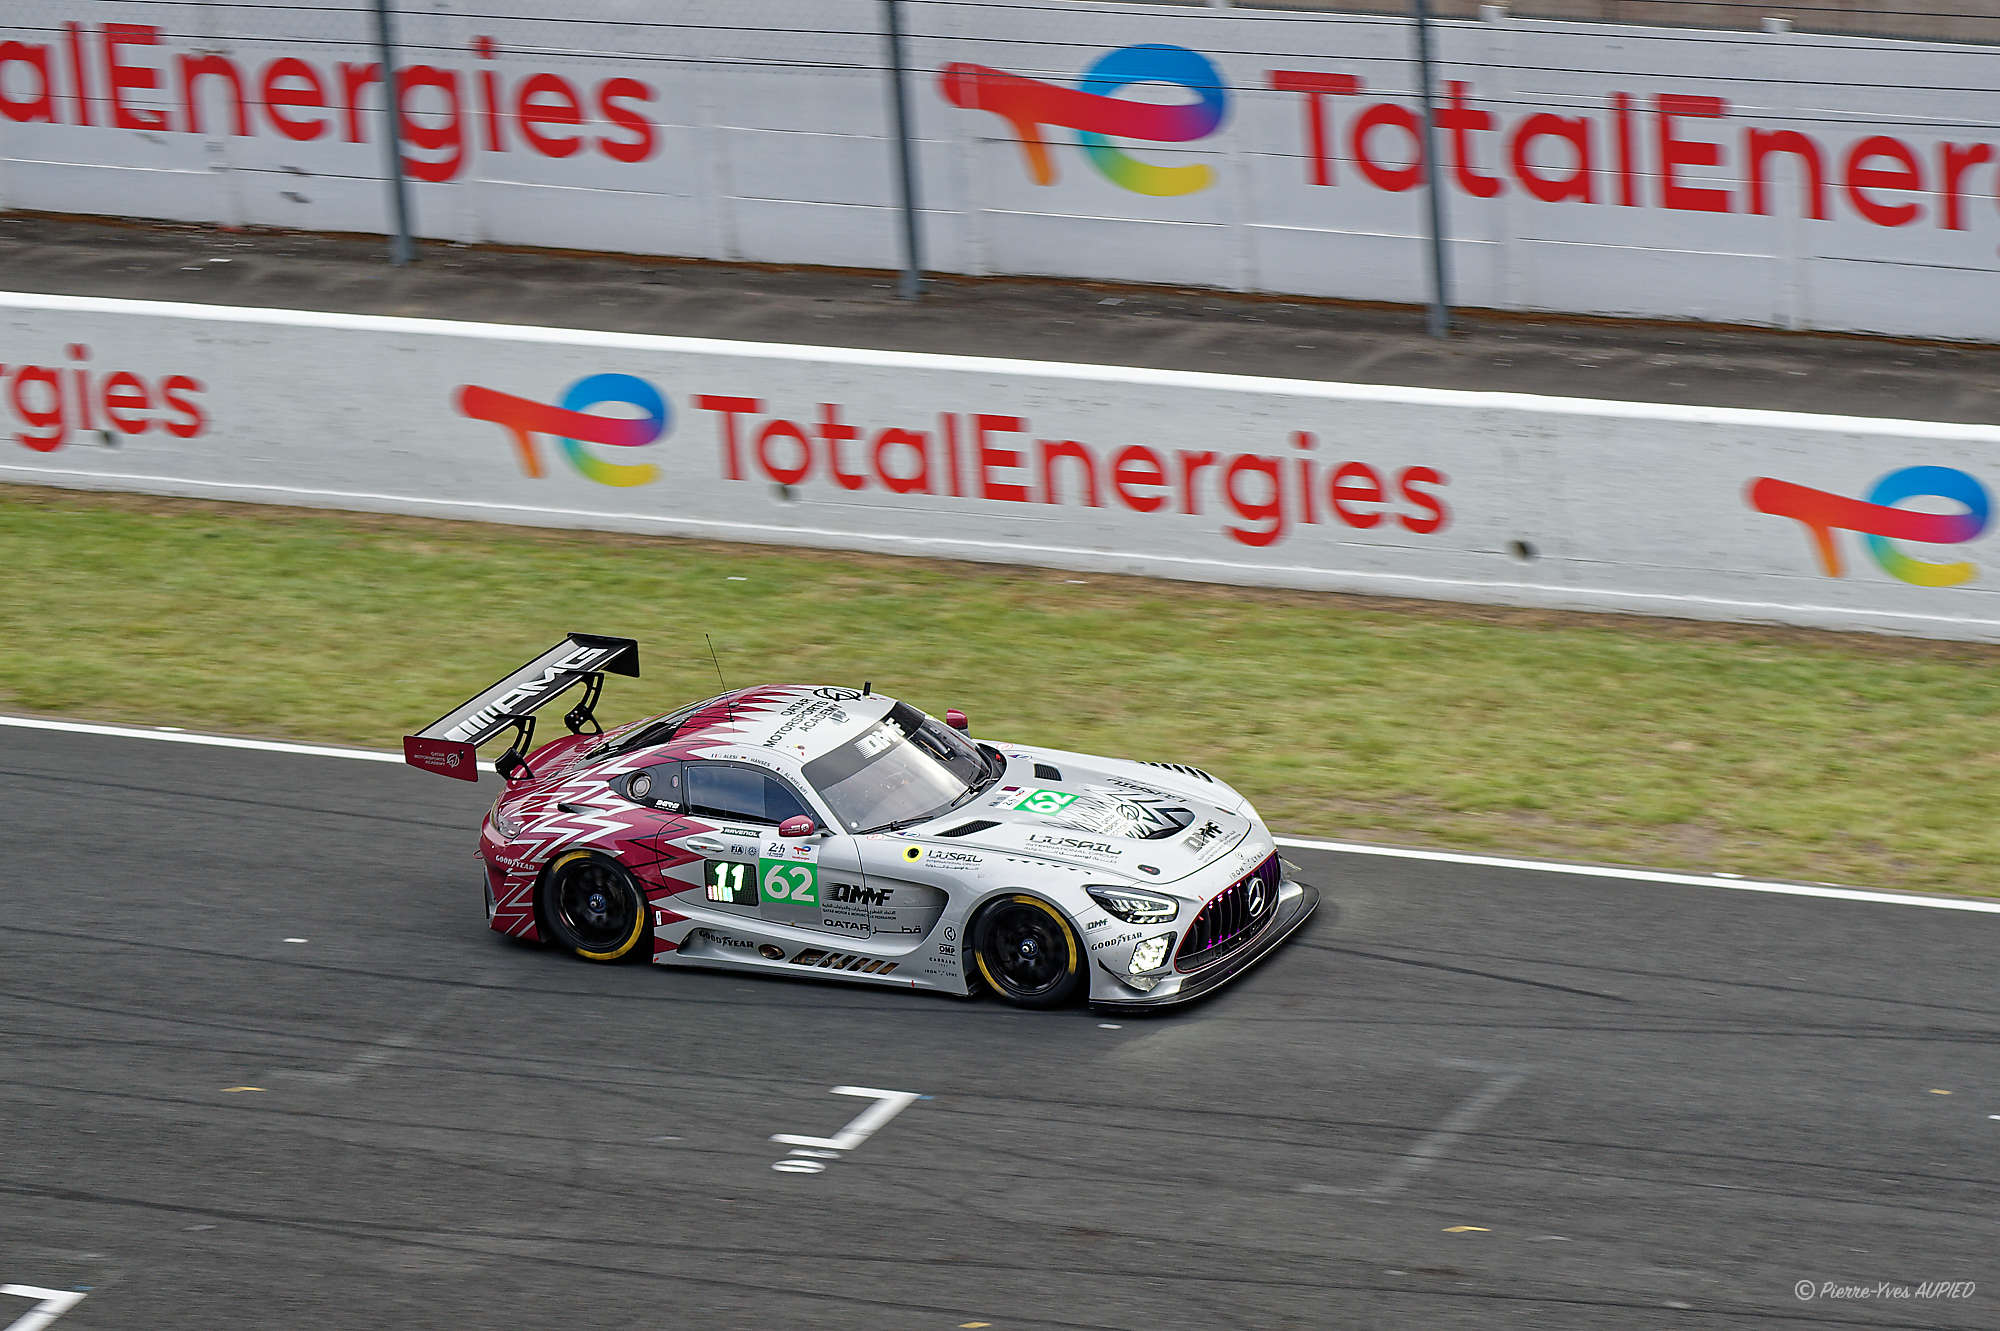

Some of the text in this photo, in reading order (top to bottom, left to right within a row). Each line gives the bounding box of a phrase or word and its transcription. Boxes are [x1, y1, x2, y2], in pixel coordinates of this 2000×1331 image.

[1268, 69, 2000, 260] TotalEner
[0, 342, 208, 453] gies
[695, 394, 1451, 547] TotalEnergies
[494, 646, 608, 715] AMG
[762, 700, 829, 748] MOTORSPORTS
[780, 698, 814, 717] QATAR
[764, 864, 815, 902] 62
[823, 919, 870, 931] QATAR
[1091, 932, 1142, 951] GOODYEAR
